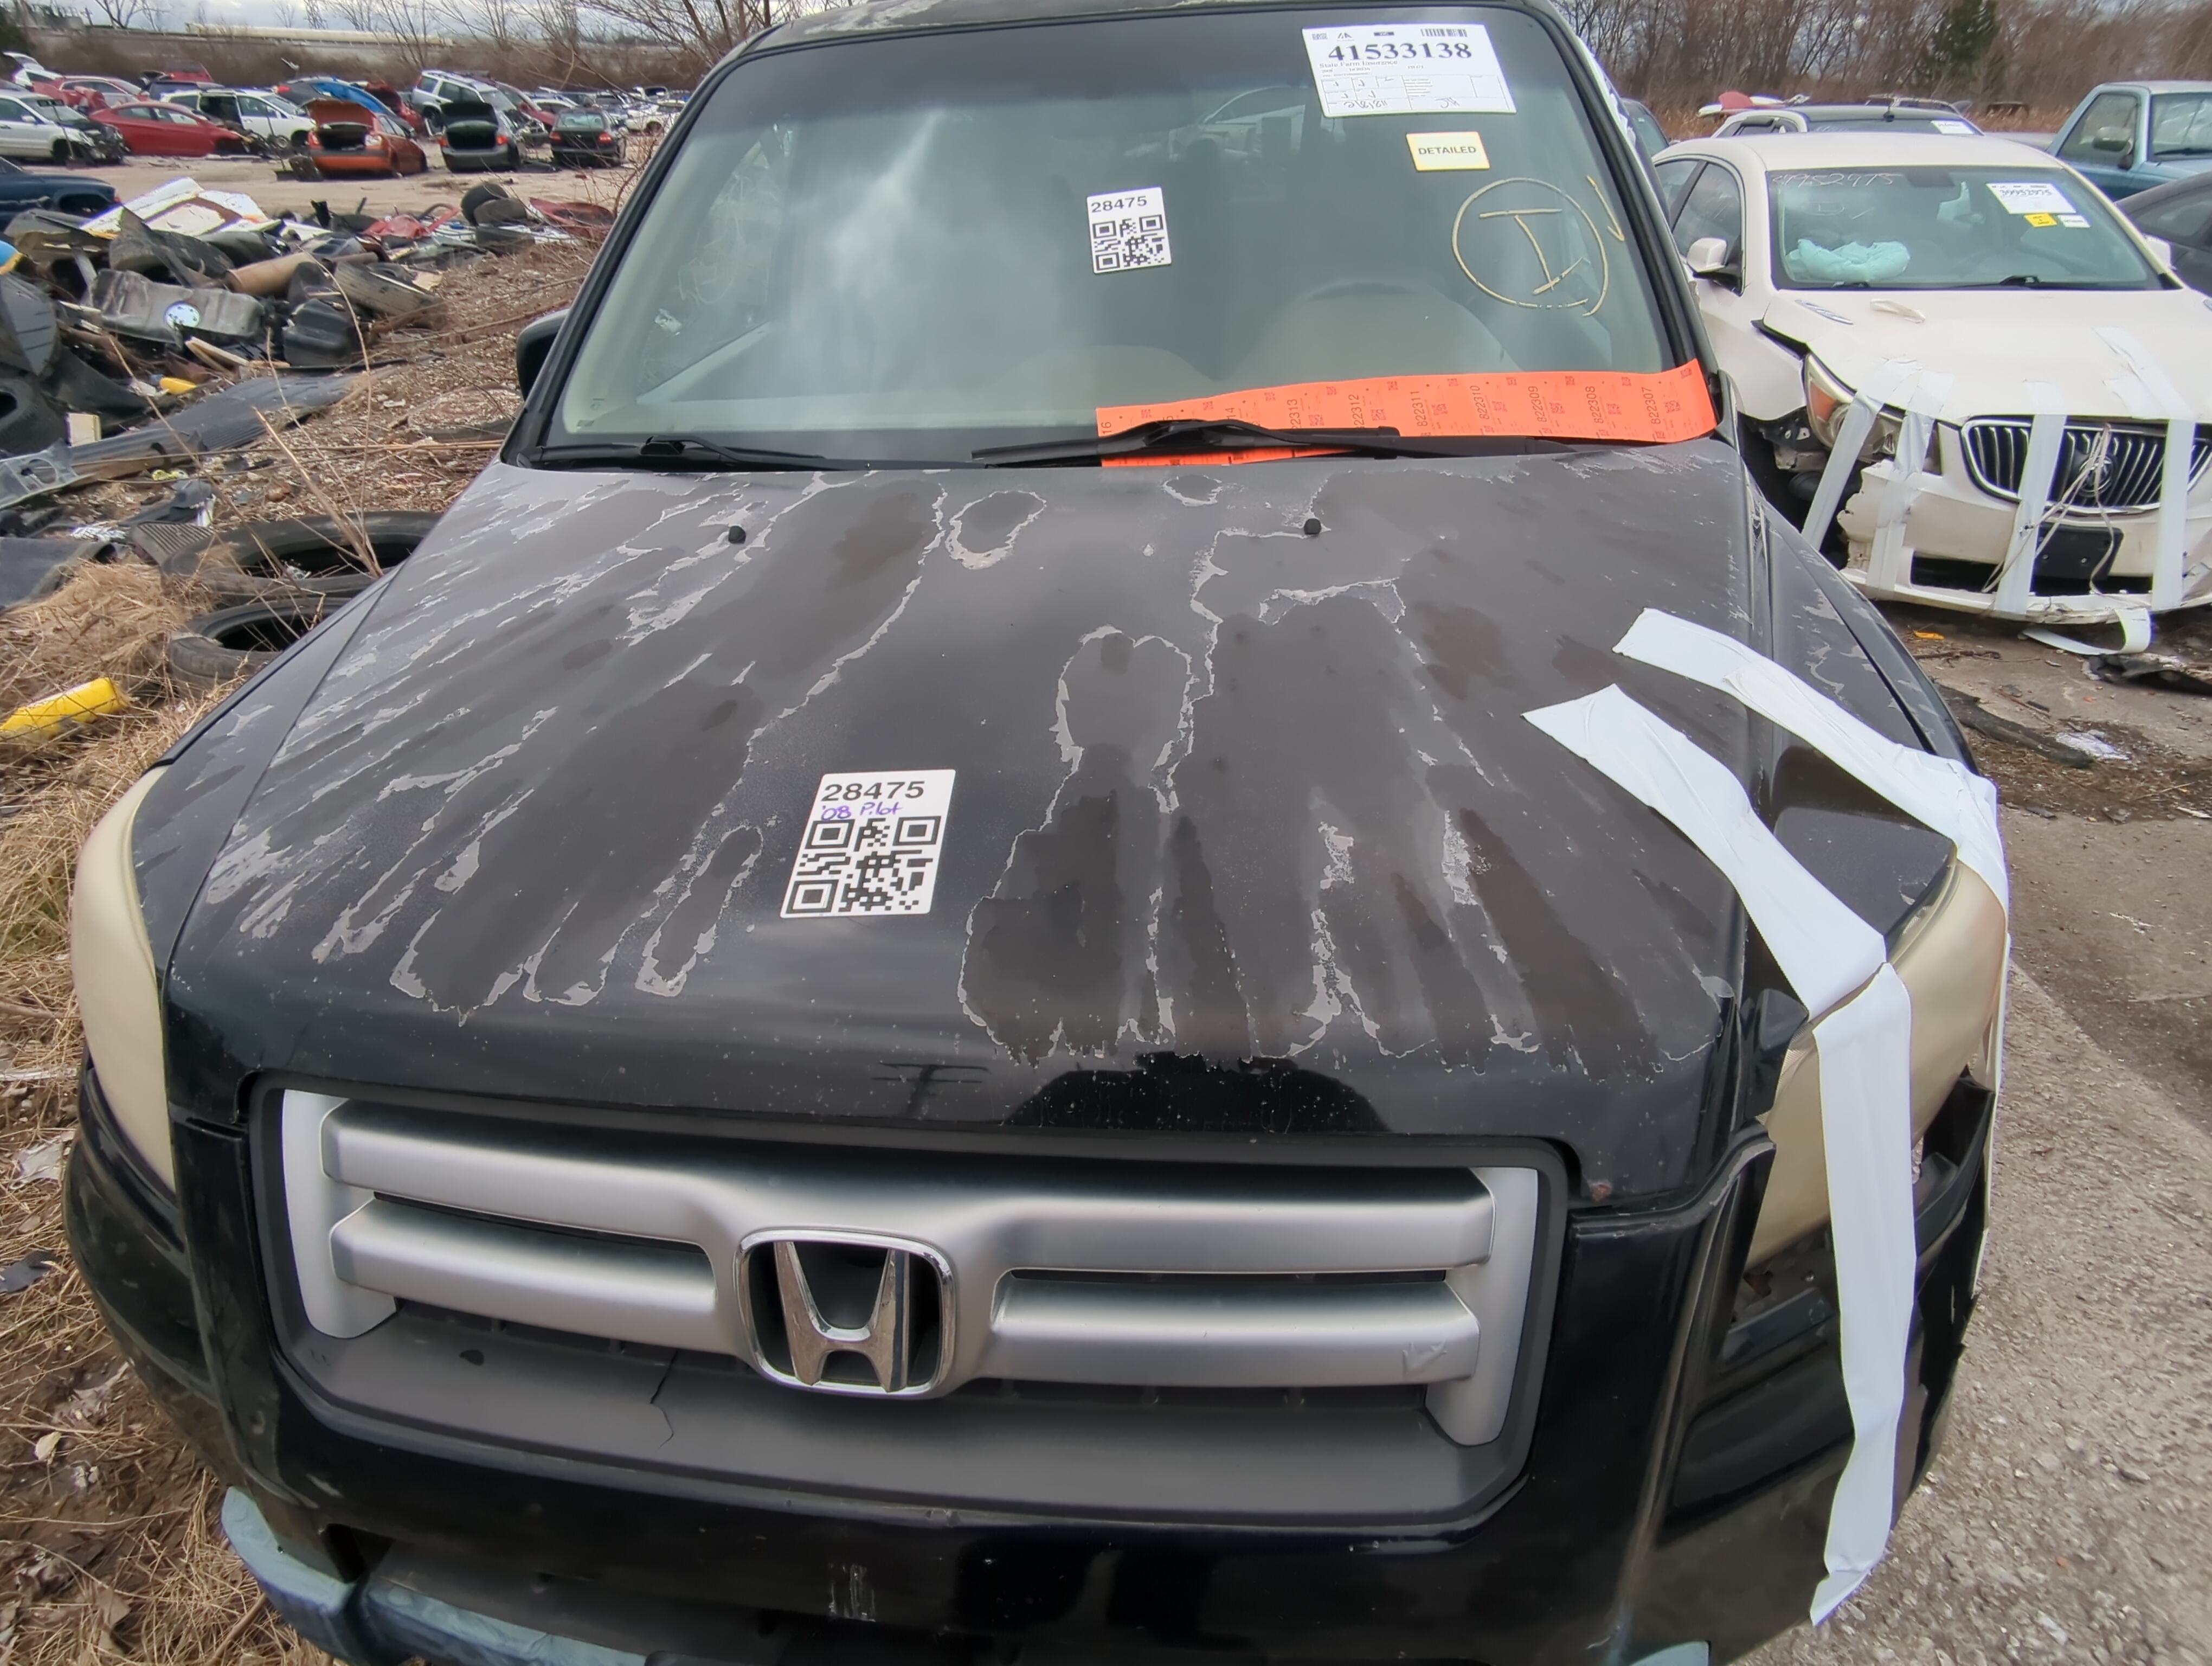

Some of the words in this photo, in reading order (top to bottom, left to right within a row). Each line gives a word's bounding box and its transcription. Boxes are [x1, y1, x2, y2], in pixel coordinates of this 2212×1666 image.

[1328, 42, 1472, 61] 41533138
[1418, 146, 1477, 155] DETAILED
[1091, 196, 1147, 213] 28475
[1348, 394, 1365, 428] 22312
[1410, 390, 1428, 427] 822311
[1469, 385, 1490, 420] 822310
[1528, 386, 1547, 422] 822309
[1585, 386, 1604, 424] 822308
[1641, 387, 1661, 425] 822307
[821, 781, 925, 801] 28475
